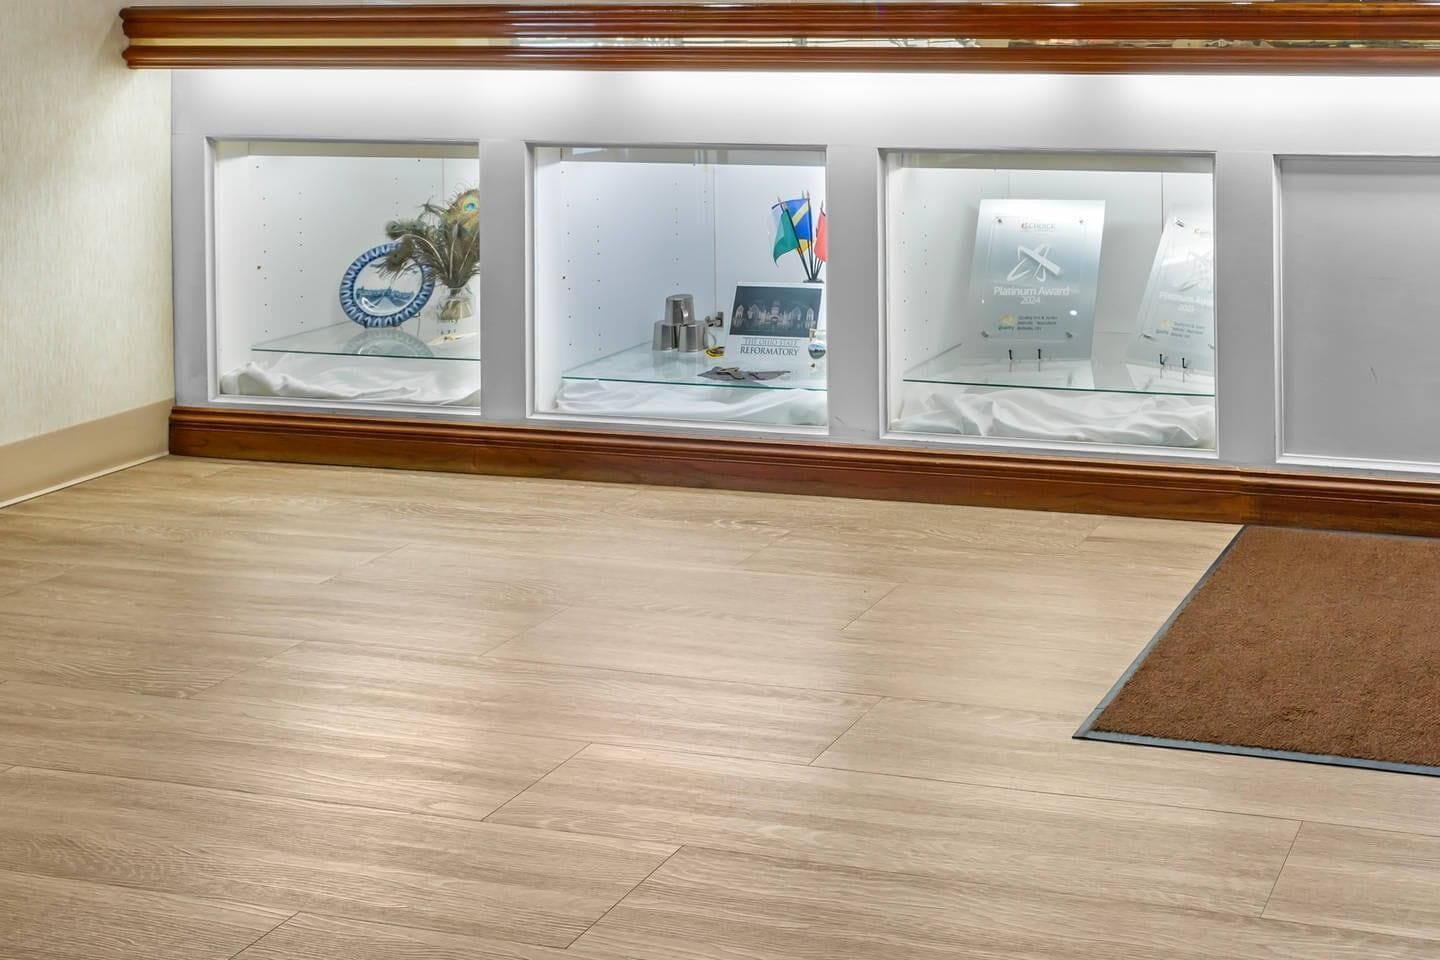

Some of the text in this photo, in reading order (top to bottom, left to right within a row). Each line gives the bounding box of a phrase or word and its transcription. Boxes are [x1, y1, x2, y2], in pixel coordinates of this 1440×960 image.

[993, 285, 1070, 296] Platinum Award
[740, 346, 800, 356] REFORMATORY
